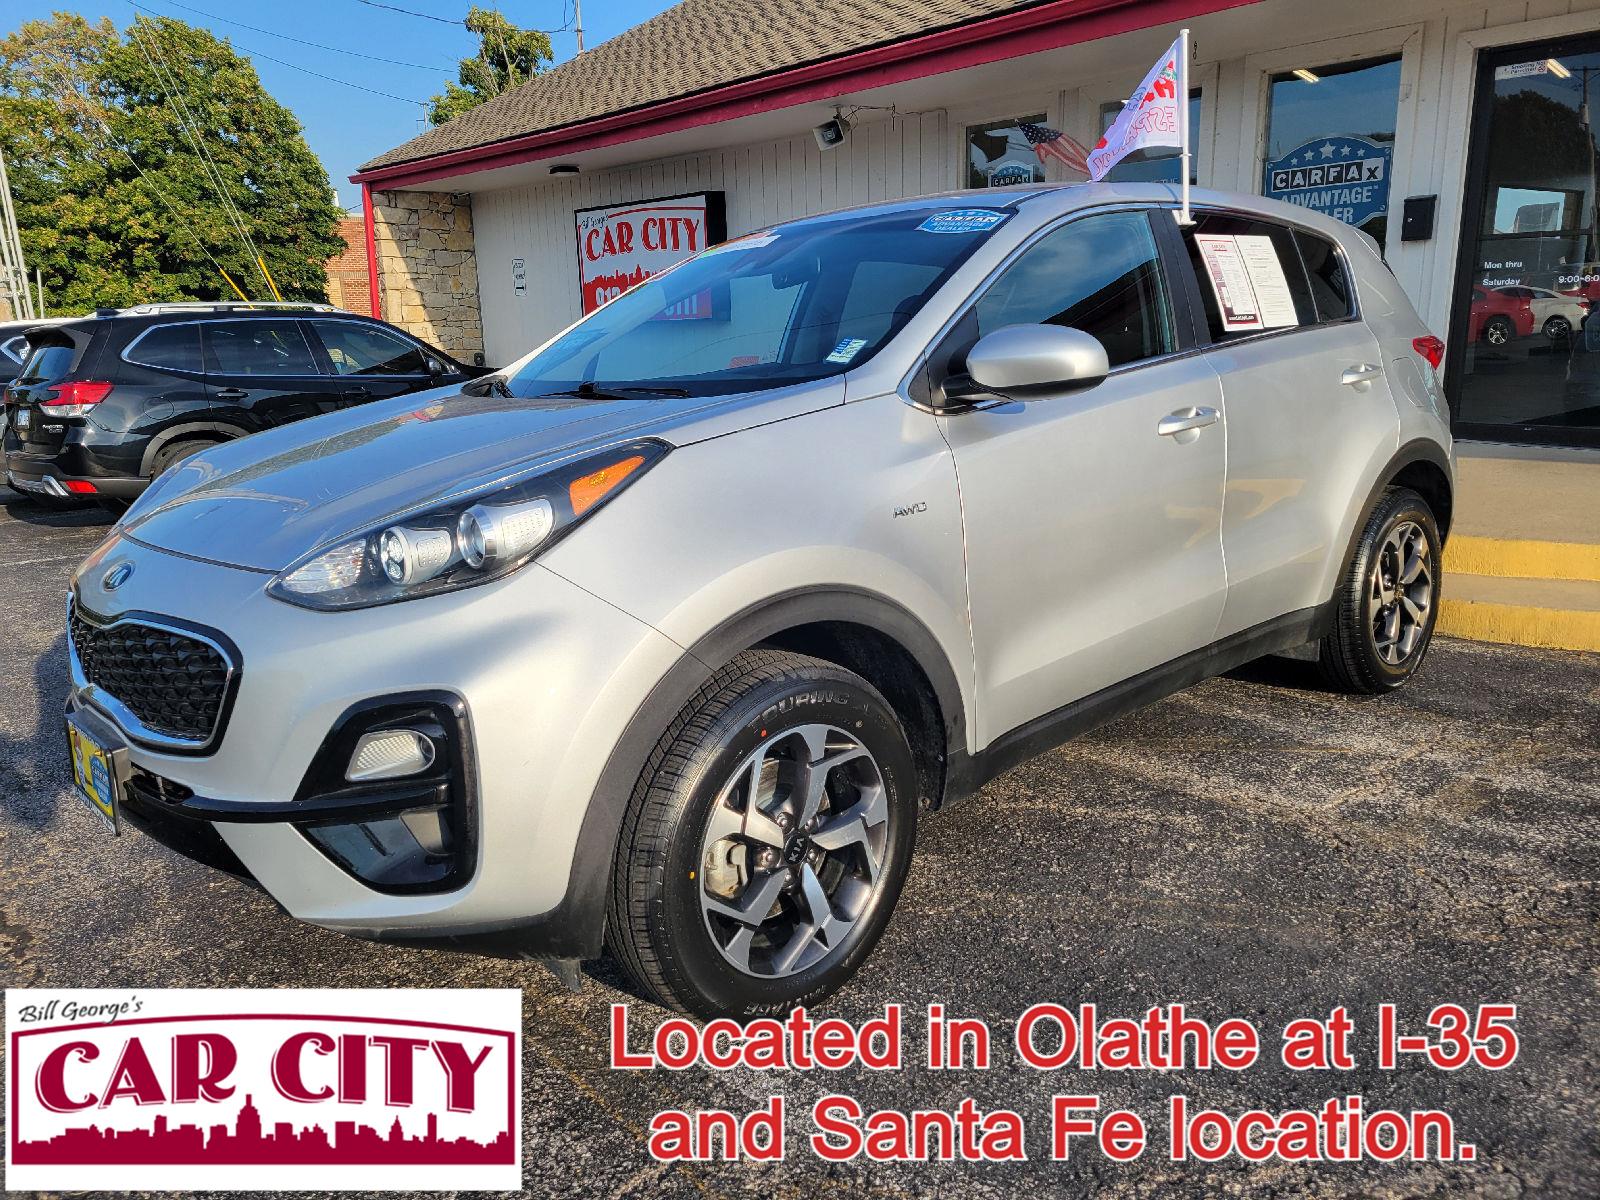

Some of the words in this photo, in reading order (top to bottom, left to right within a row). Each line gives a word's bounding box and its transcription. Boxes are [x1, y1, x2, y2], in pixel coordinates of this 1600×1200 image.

[1274, 164, 1380, 189] CARFAX
[585, 222, 634, 261] CAR
[641, 217, 699, 253] CITY
[1484, 261, 1502, 269] Mon
[1505, 260, 1523, 268] thru
[1482, 277, 1521, 286] Saturday
[893, 502, 927, 518] AWD
[788, 838, 805, 861] KIA
